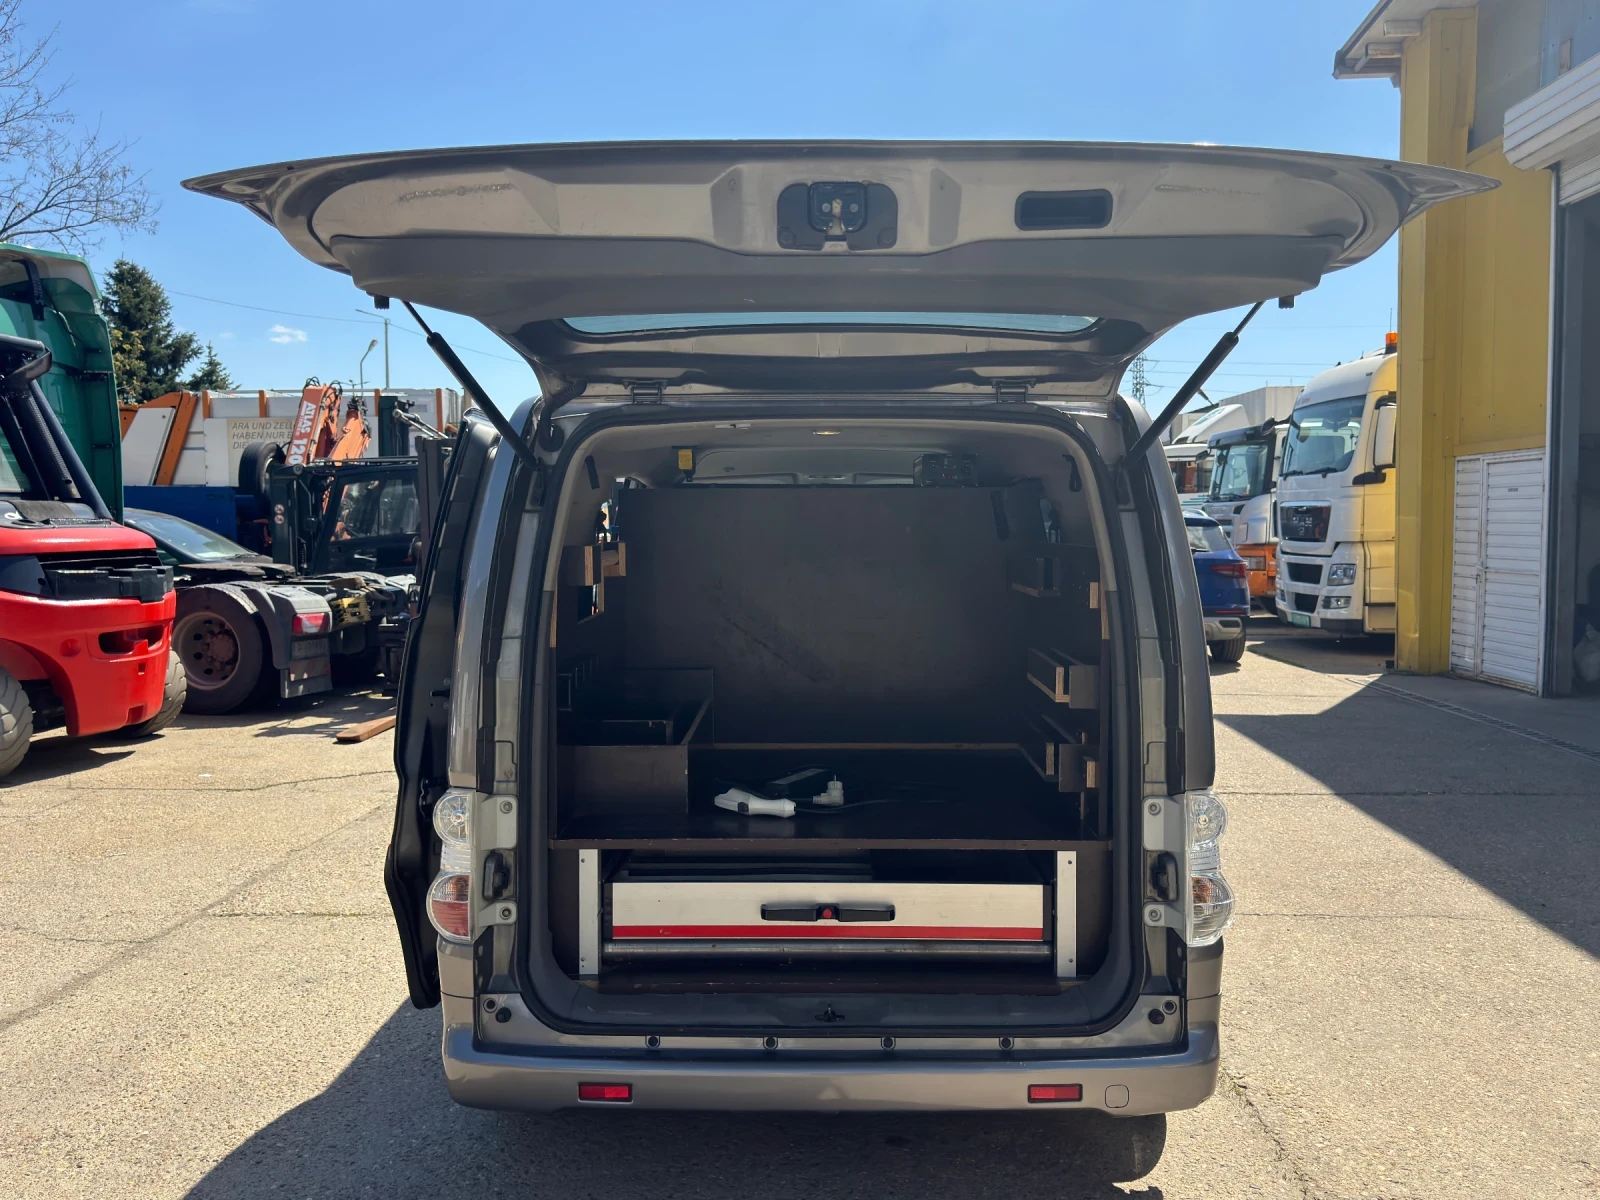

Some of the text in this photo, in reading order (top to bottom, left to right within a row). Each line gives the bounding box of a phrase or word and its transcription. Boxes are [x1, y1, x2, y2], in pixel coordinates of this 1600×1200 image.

[231, 422, 249, 430] ARA
[252, 422, 271, 430] UND
[301, 401, 317, 434] ATLAS
[232, 431, 263, 440] HABEN
[265, 431, 286, 440] NUR
[288, 438, 308, 465] 120
